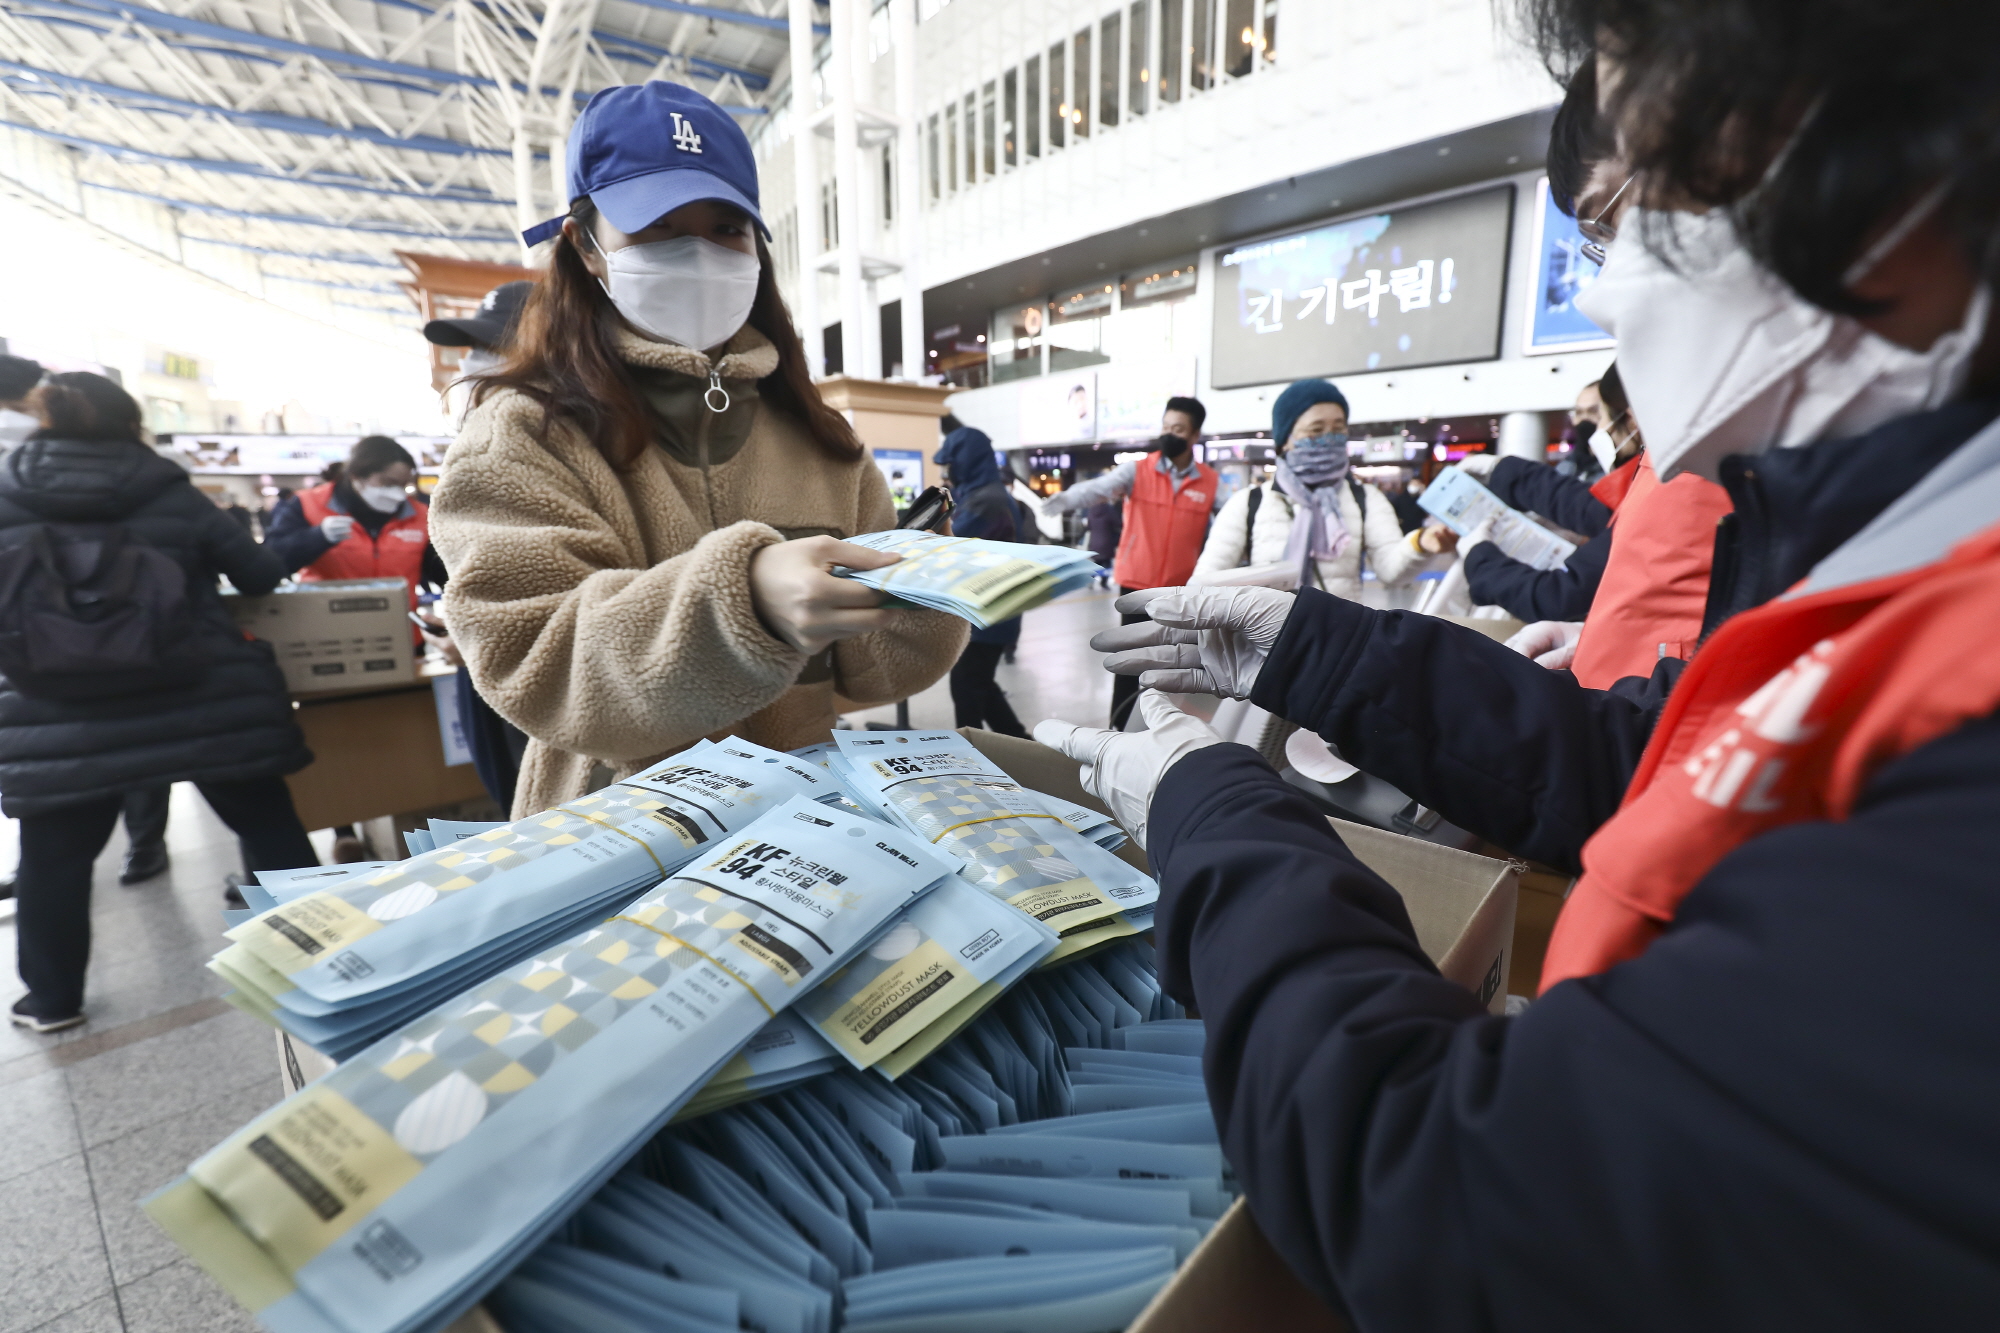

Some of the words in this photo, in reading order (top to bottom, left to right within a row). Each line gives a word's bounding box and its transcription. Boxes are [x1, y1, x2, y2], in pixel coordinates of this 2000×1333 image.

[670, 112, 702, 154] LA
[1246, 288, 1283, 334] 긴
[1297, 257, 1455, 325] 기다림!
[675, 766, 712, 777] KF
[884, 756, 911, 768] KF
[894, 764, 924, 775] 94
[651, 772, 688, 785] 94
[691, 777, 728, 790] 스타일
[743, 842, 791, 862] KF
[719, 857, 765, 880] 94
[770, 867, 819, 890] 스타일
[788, 855, 849, 887] 뉴크린웰
[754, 876, 835, 920] 황사방역용마스크
[1071, 892, 1094, 901] MASK
[750, 929, 771, 944] LARGE
[971, 951, 984, 962] MADE
[989, 937, 1003, 949] KOREA
[850, 980, 915, 1034] YELLOWDUST
[916, 961, 943, 985] MASK
